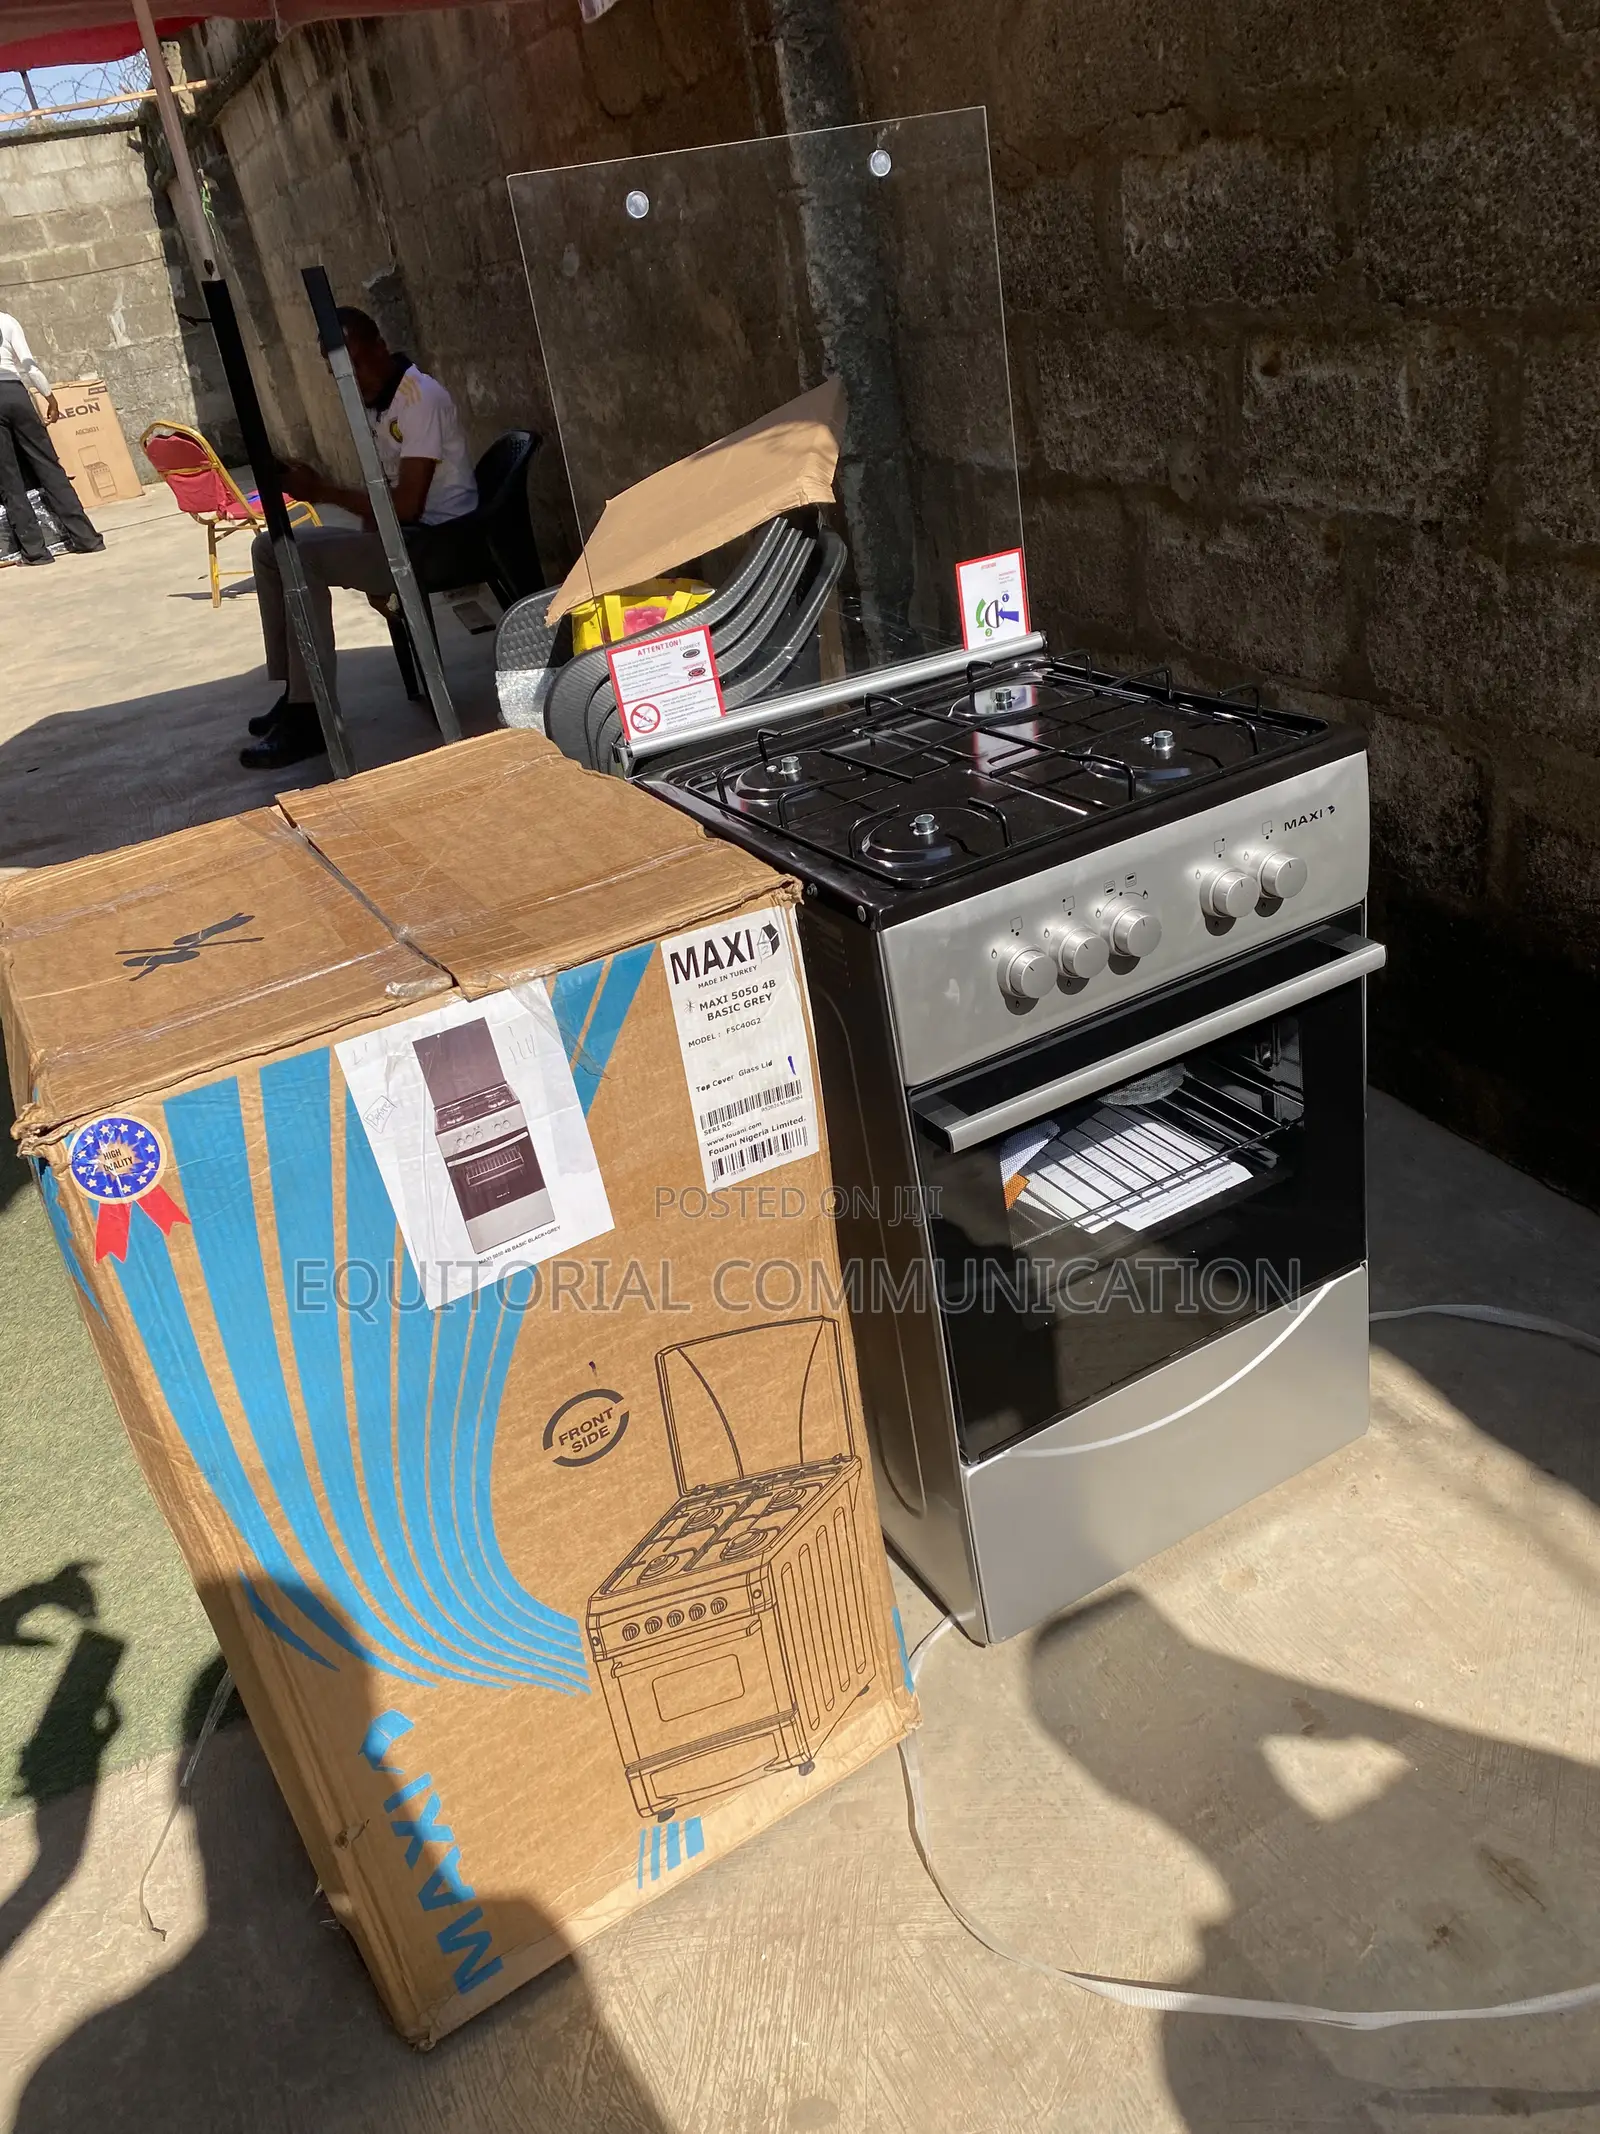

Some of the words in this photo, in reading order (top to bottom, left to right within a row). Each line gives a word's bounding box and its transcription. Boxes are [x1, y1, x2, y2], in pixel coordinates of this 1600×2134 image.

[637, 639, 682, 656] ATTENTION!
[1284, 809, 1323, 831] MAXI
[670, 929, 755, 985] MAXI
[697, 978, 718, 989] MADE
[719, 974, 728, 983] IN
[729, 965, 758, 978] TURKEY
[699, 994, 729, 1012] MAXI
[731, 984, 759, 1001] 5050
[762, 979, 776, 990] 4B
[706, 1003, 741, 1021] BASIC
[743, 992, 773, 1009] GREY
[688, 1032, 716, 1048] MODEL
[696, 1083, 711, 1093] Top
[712, 1074, 735, 1088] Cover
[738, 1064, 760, 1077] Glass
[761, 1059, 773, 1069] Lid
[704, 1126, 720, 1136] SERI
[708, 1141, 738, 1157] Fouani
[739, 1127, 770, 1144] Nigeria
[103, 1148, 122, 1160] HIGH
[512, 1240, 528, 1250] BASIC
[558, 1407, 613, 1446] FRONT
[571, 1425, 611, 1453] SIDE
[382, 1771, 504, 1995] MAXI
